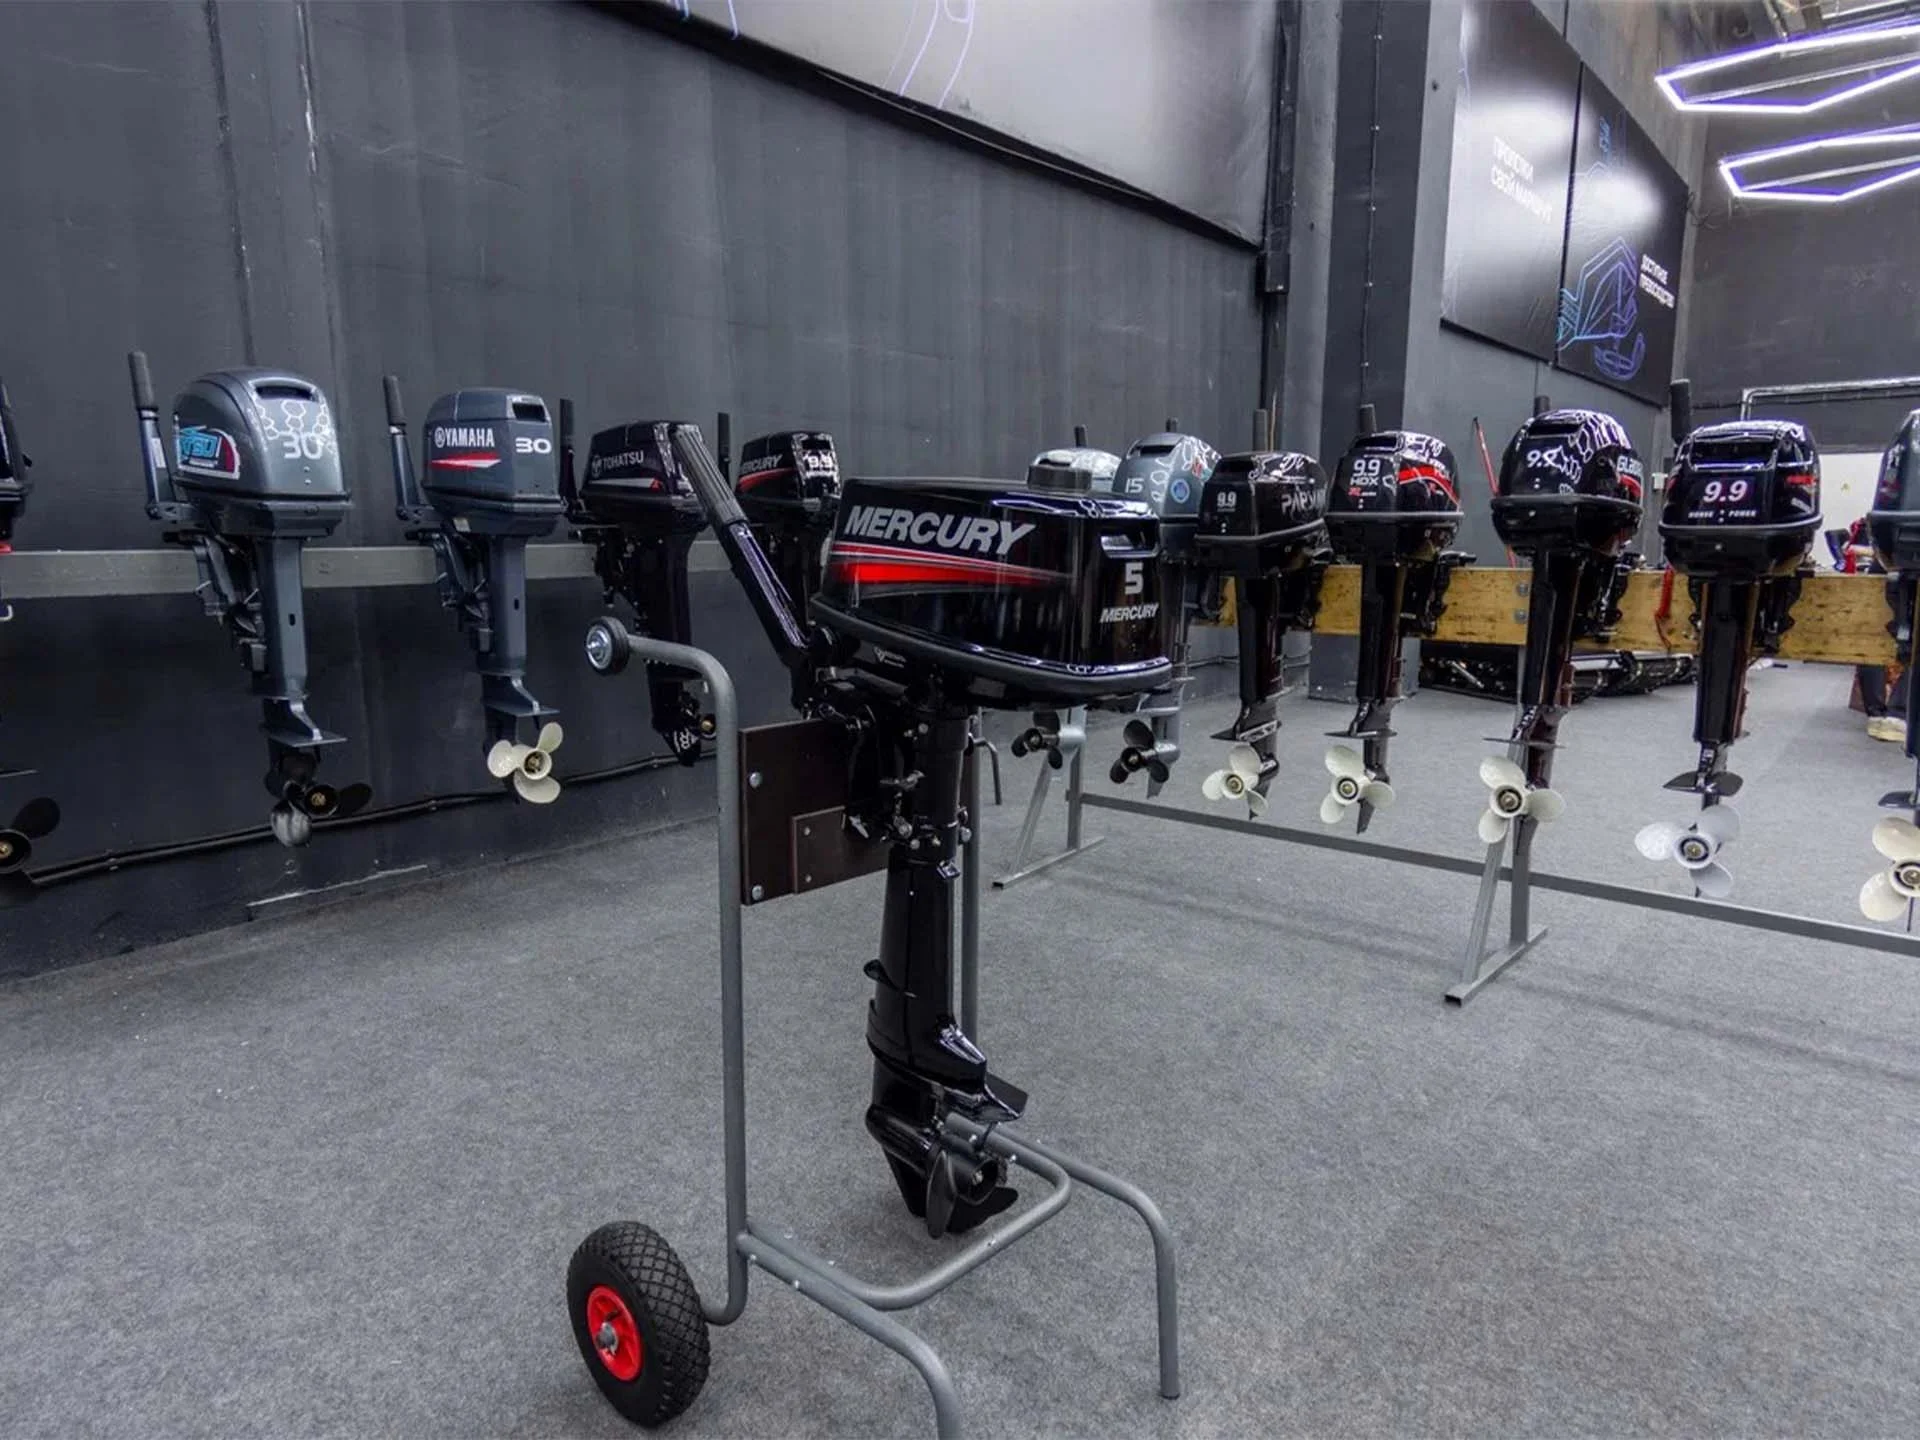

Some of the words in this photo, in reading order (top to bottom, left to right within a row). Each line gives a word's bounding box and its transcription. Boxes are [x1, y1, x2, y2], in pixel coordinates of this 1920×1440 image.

[282, 432, 323, 460] 30
[445, 427, 496, 448] YAMAHA
[515, 436, 552, 454] 30
[604, 450, 644, 470] TOHATSU
[740, 454, 784, 474] ERCURY
[1352, 459, 1381, 477] 9.9
[1124, 477, 1145, 494] 15
[1350, 476, 1380, 487] HDX
[1702, 479, 1749, 503] 9.9
[1217, 491, 1238, 508] 9.9
[844, 505, 1037, 556] MERCURY
[1124, 561, 1144, 595] 5
[1099, 603, 1160, 624] MERCURY
